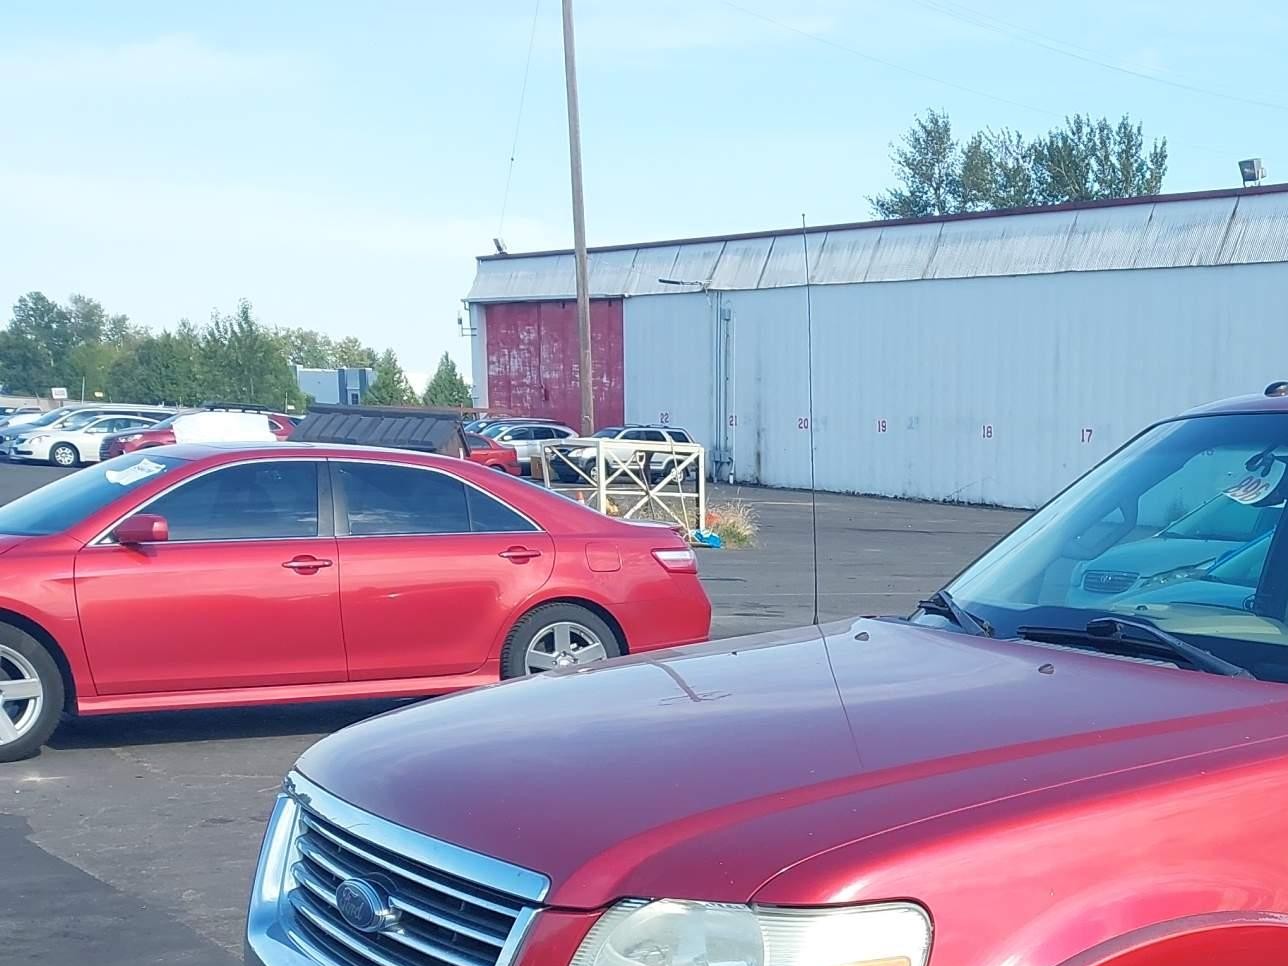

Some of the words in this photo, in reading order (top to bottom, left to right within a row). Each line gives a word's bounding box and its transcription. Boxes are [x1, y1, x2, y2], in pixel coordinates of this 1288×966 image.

[660, 412, 670, 424] 22
[728, 415, 738, 427] 21
[798, 417, 809, 430] 20
[877, 420, 887, 433] 19
[982, 425, 993, 439] 18
[1081, 428, 1093, 443] 17
